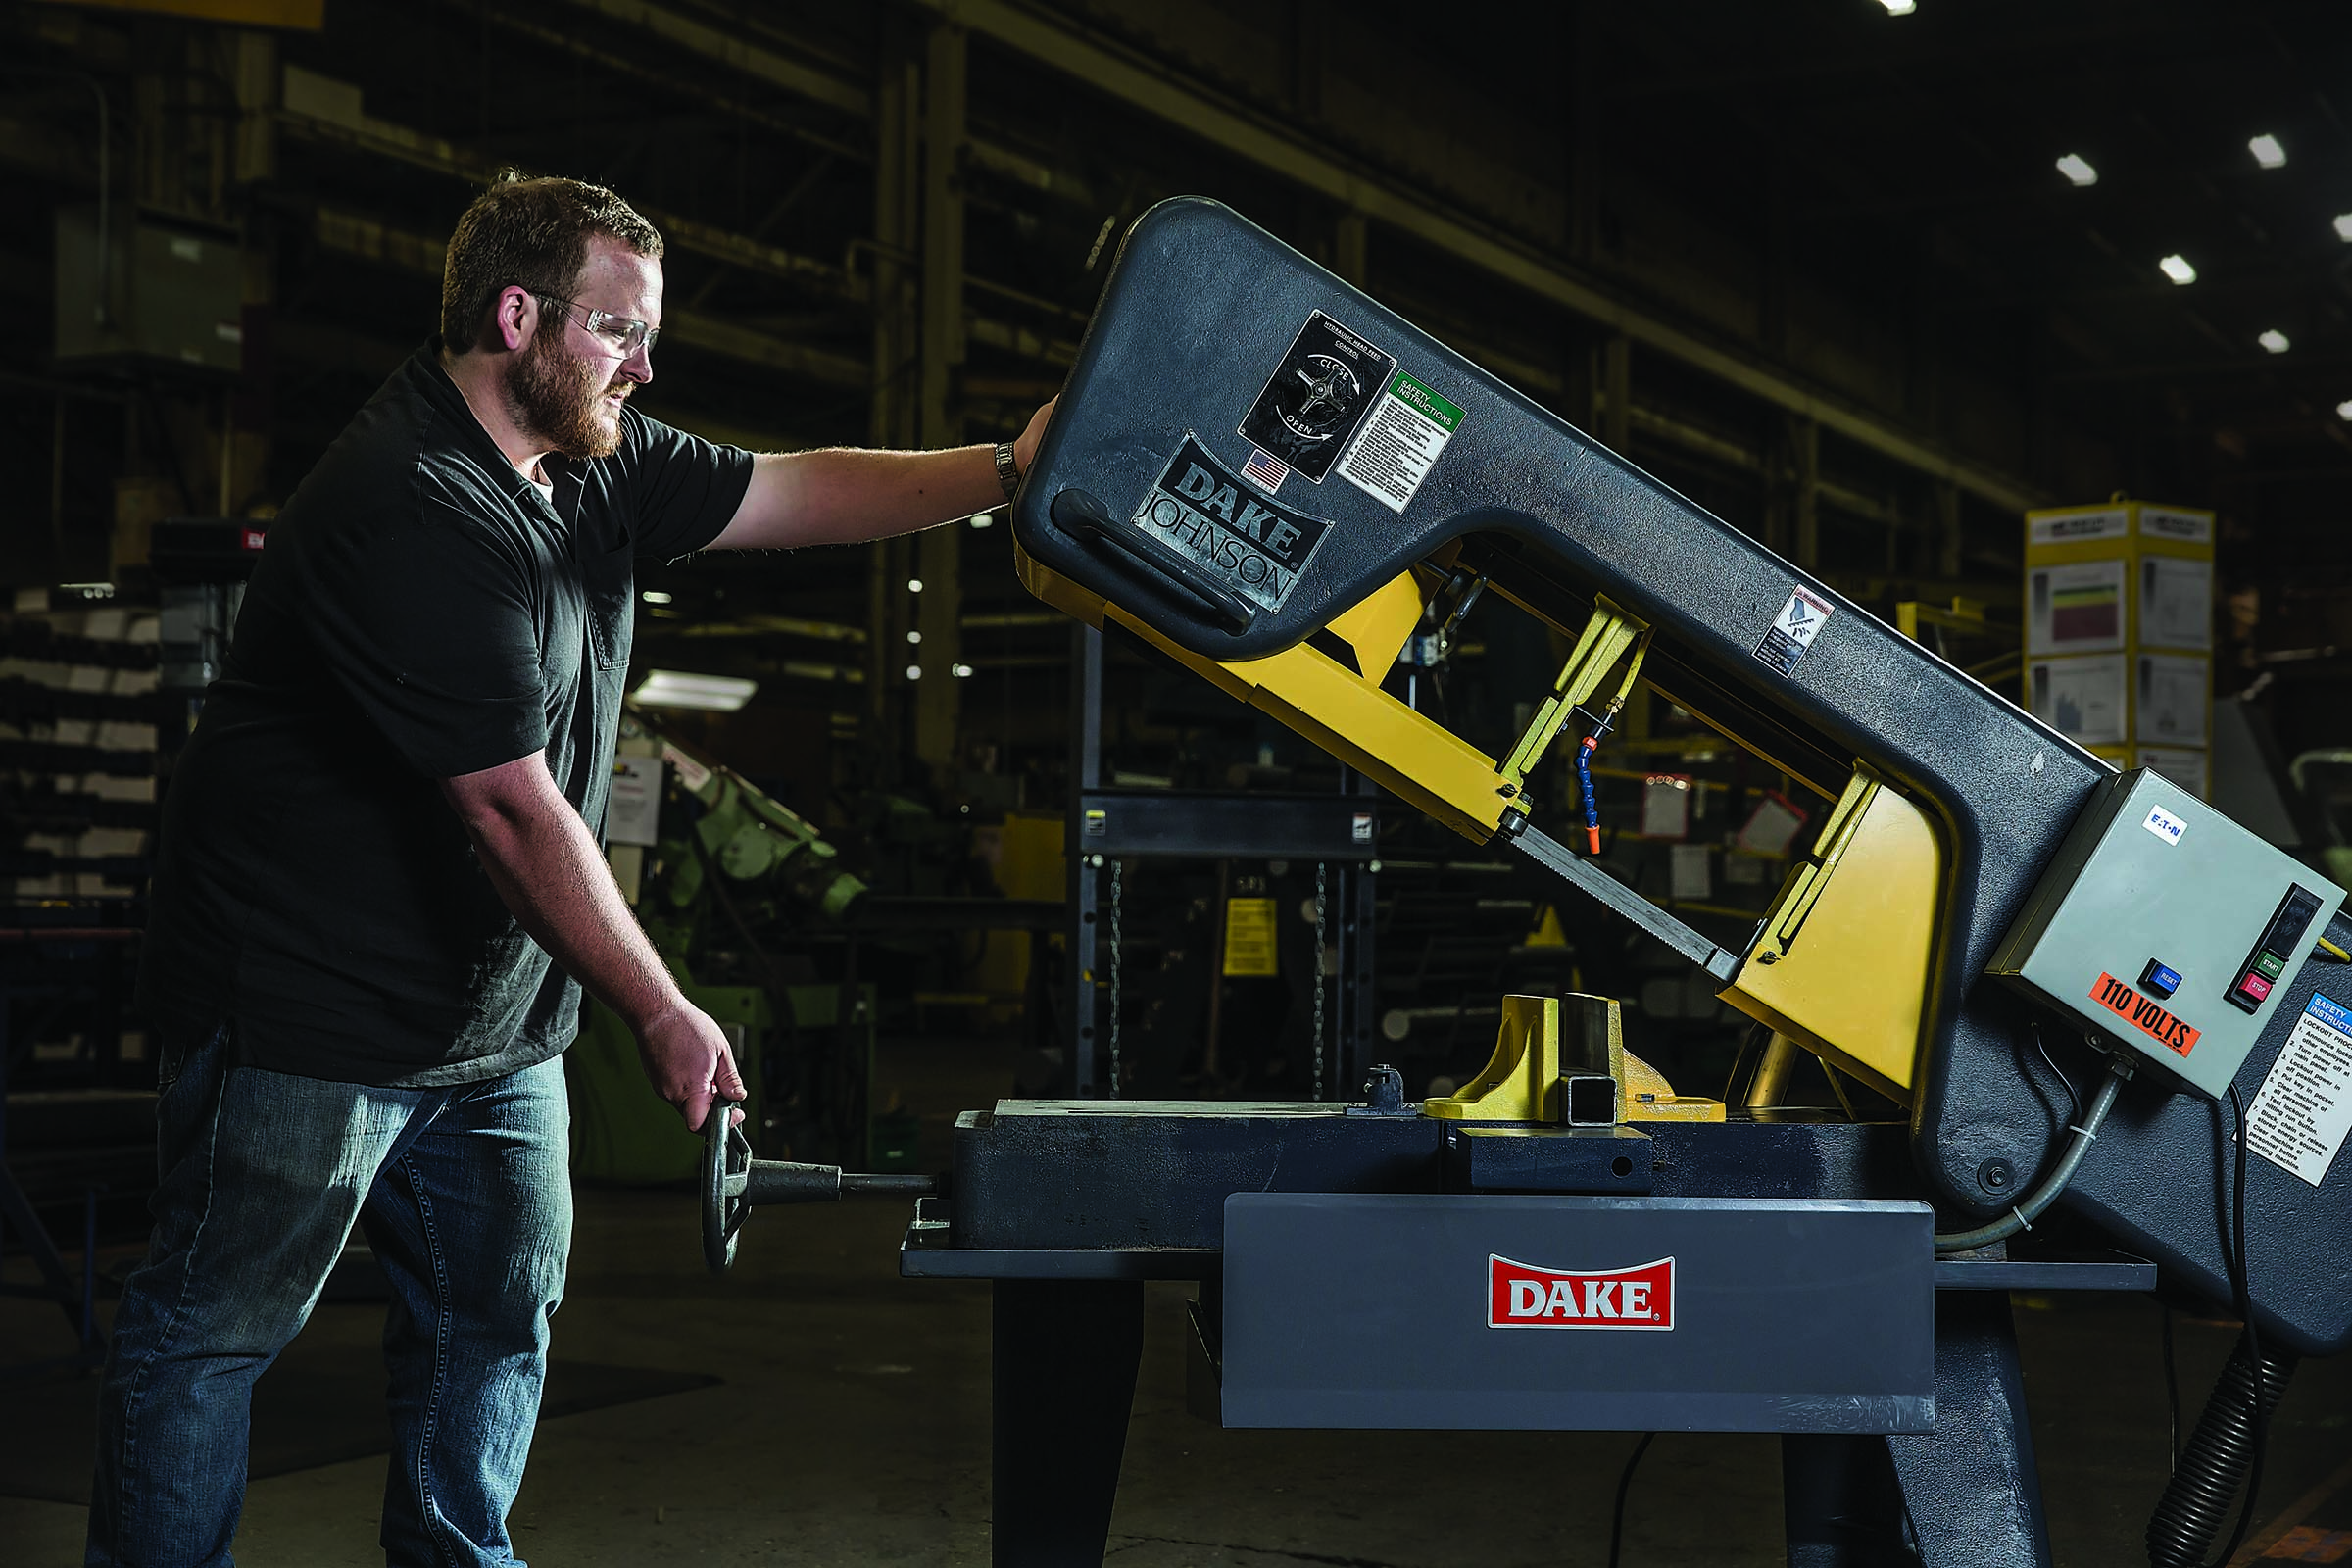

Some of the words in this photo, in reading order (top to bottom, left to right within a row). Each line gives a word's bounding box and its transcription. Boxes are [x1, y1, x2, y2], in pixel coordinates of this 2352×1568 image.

[1335, 340, 1359, 358] CONTROL
[1401, 380, 1430, 401] SAFETY
[1397, 387, 1452, 425] INSTRUCTIONS
[1286, 415, 1313, 435] OPEN
[1174, 462, 1303, 560] DAKE
[1138, 491, 1293, 602] JOHNSON
[2263, 959, 2278, 972] START
[2161, 972, 2178, 986] RESET
[2252, 982, 2266, 993] STOP
[2101, 977, 2134, 1012] 110
[2133, 998, 2191, 1049] VOLTS
[2315, 998, 2346, 1019] SAFETY
[2303, 1019, 2332, 1037] LOCKOUT
[2306, 1031, 2335, 1050] Announce
[2294, 1052, 2309, 1062] main
[2310, 1060, 2328, 1073] panel.
[2298, 1045, 2312, 1055] Turn
[2313, 1054, 2331, 1067] power
[2302, 1038, 2318, 1049] other
[2319, 1048, 2352, 1068] employees.
[2290, 1059, 2313, 1074] Lockout
[2315, 1074, 2332, 1087] power
[2296, 1072, 2322, 1088] position.
[2278, 1081, 2293, 1093] Clear
[2294, 1092, 2319, 1107] machine
[2282, 1073, 2292, 1082] Put
[2293, 1080, 2305, 1090] key
[2314, 1092, 2336, 1106] pocket.
[2270, 1096, 2281, 1105] Test
[2283, 1104, 2305, 1118] lockout
[2282, 1094, 2313, 1113] personnel.
[2265, 1103, 2283, 1116] hitting
[2298, 1121, 2319, 1135] button.
[2249, 1131, 2278, 1150] personnel
[2279, 1149, 2298, 1160] before
[2253, 1124, 2269, 1136] Clear
[2270, 1134, 2294, 1151] machine
[2258, 1117, 2276, 1130] stored
[2277, 1129, 2297, 1143] energy
[2299, 1141, 2324, 1156] sources.
[2281, 1121, 2297, 1133] chain
[2308, 1137, 2328, 1151] release
[2275, 1154, 2301, 1171] machine.
[1508, 1280, 1651, 1318] DAKE
